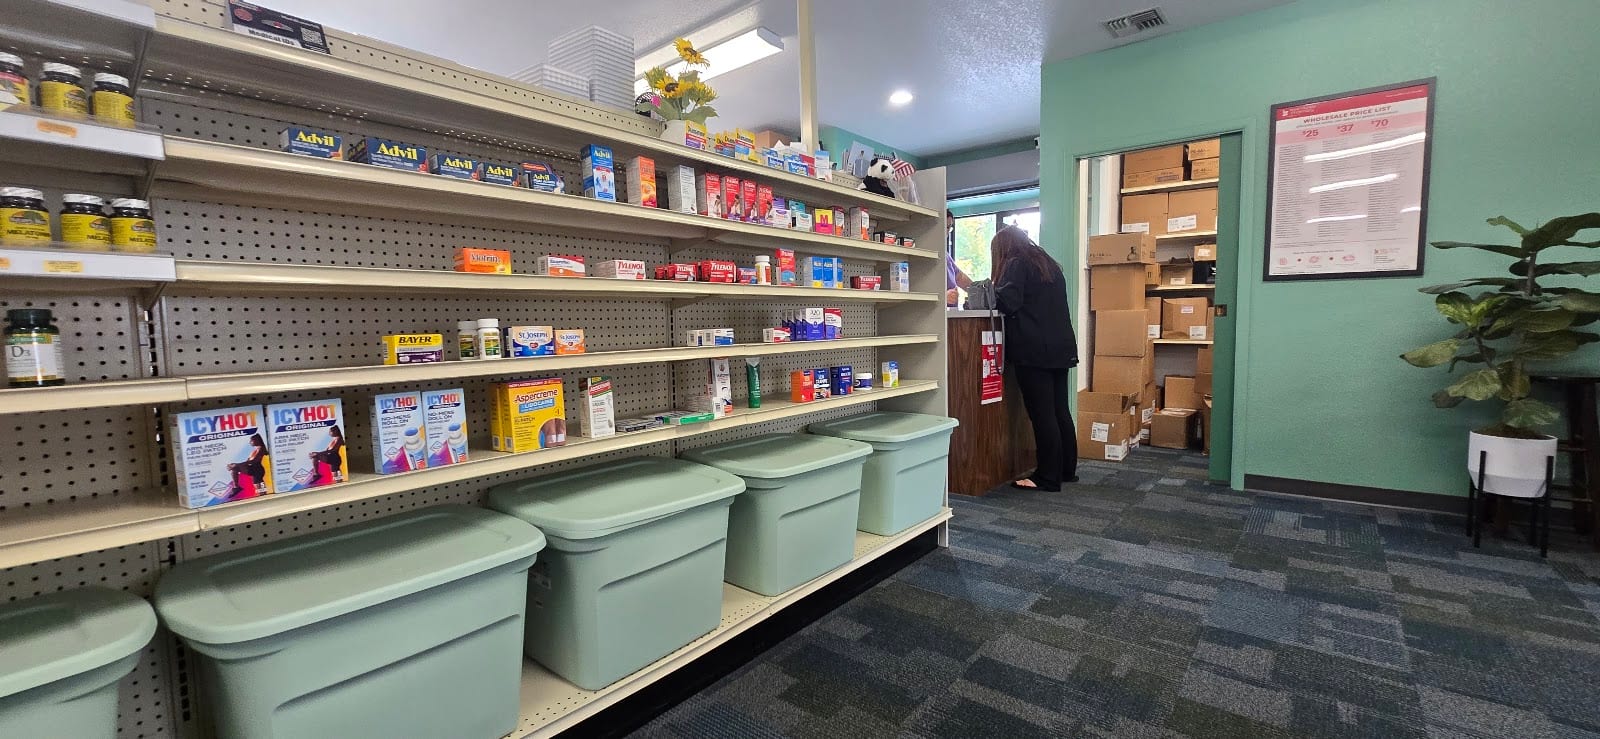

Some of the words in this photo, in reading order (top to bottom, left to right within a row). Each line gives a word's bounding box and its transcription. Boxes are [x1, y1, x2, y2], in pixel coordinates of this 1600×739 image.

[1303, 113, 1347, 123] WHOLESALE
[1349, 108, 1371, 117] PRICE
[1374, 105, 1392, 113] LIST
[1371, 119, 1388, 128] $70
[1302, 129, 1319, 138] $25
[295, 131, 334, 147] Advil
[377, 143, 417, 160] Advil
[594, 150, 610, 159] Advil
[444, 157, 473, 170] Advil
[487, 165, 513, 177] Advil
[533, 173, 550, 181] Advil
[471, 253, 498, 264] Motrin
[617, 261, 643, 270] TYLENOL
[711, 261, 732, 271] TYLENOL
[399, 336, 432, 344] BAYER
[514, 389, 558, 404] Aspercreme
[274, 404, 336, 426] ICYHOT
[184, 411, 257, 436] ICYHOT
[286, 422, 327, 431] ORIGINAL
[199, 431, 247, 441] ORIGINAL
